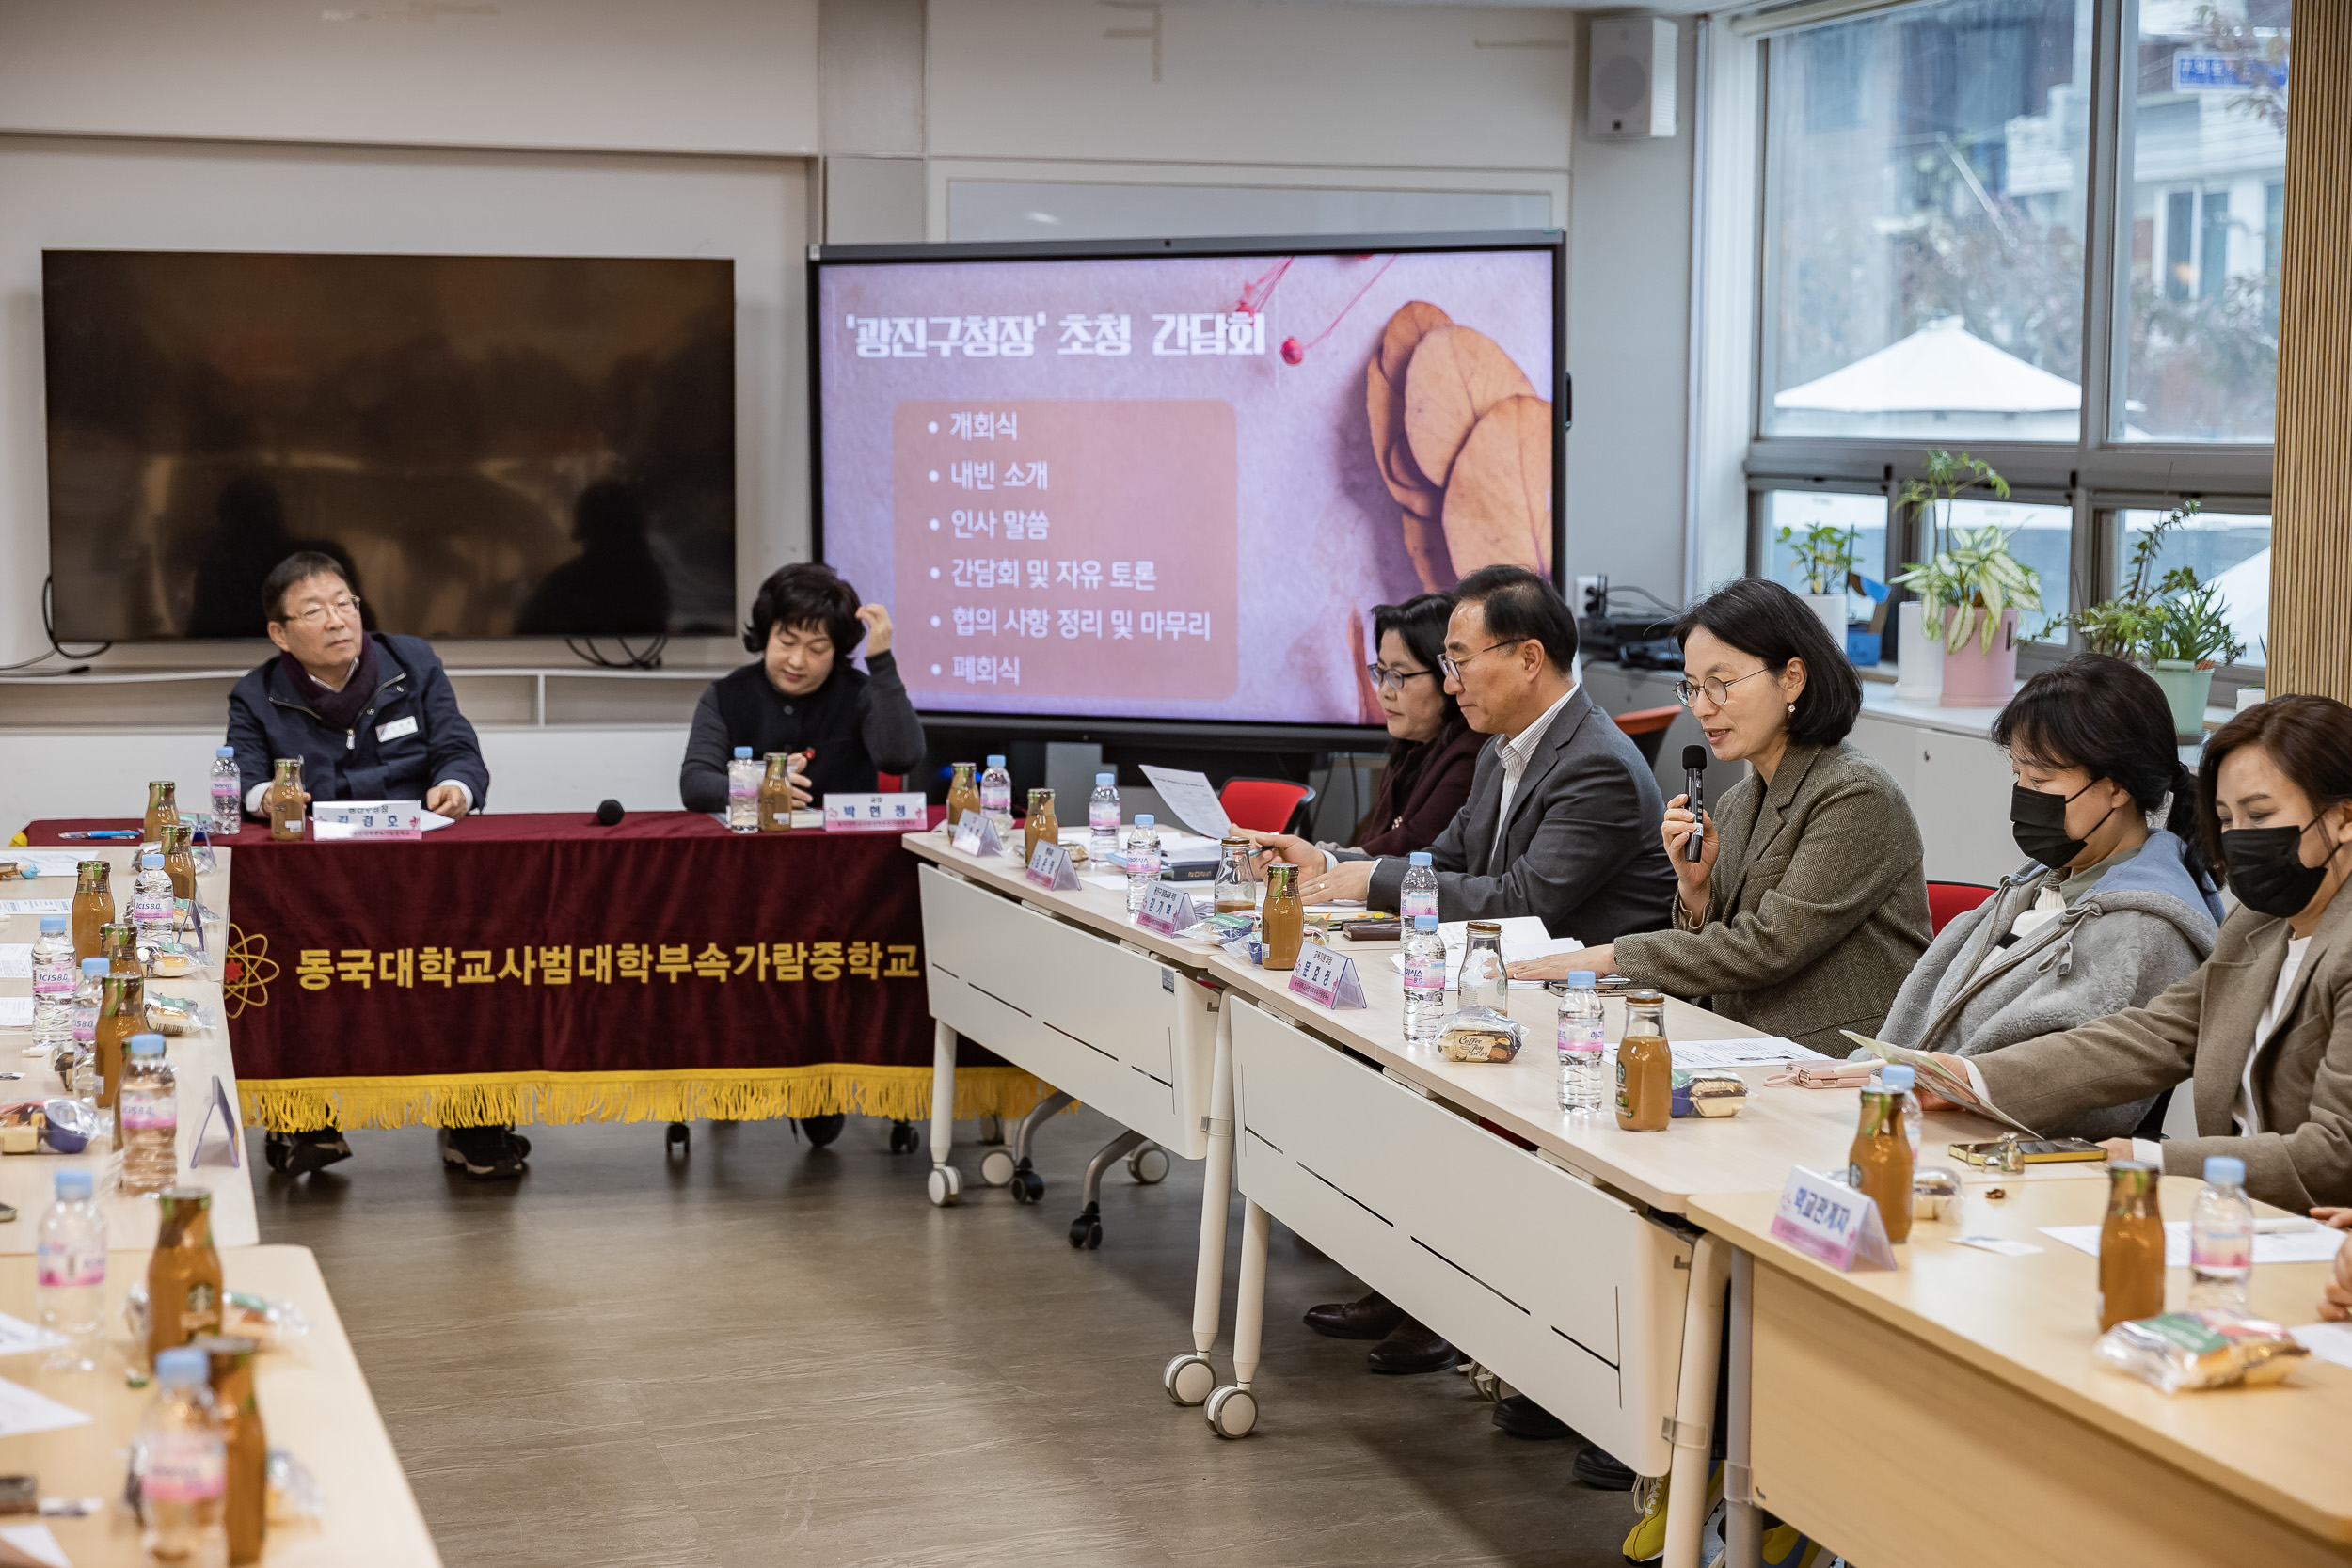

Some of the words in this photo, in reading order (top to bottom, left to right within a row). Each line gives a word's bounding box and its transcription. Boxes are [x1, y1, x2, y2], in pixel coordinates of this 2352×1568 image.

[1057, 314, 1132, 356] 초청
[1152, 312, 1266, 356] 간담회
[950, 412, 1018, 441] 개회식
[950, 461, 996, 490] 내빈
[1003, 461, 1049, 491] 소개
[951, 510, 998, 540] 인사
[1003, 510, 1050, 541] 말씀
[951, 559, 1020, 590] 간담회
[1027, 560, 1049, 590] 및
[1056, 560, 1104, 591] 자유
[1110, 561, 1157, 592] 토론
[952, 607, 998, 637] 협의
[1004, 608, 1050, 640] 사항
[1057, 610, 1103, 640] 정리
[1111, 610, 1134, 641] 및
[1139, 611, 1212, 642] 마무리
[952, 656, 1021, 686] 폐회식
[39, 973, 56, 982] ICIS
[296, 942, 920, 990] 동국대학교사범대학부속가람중학교
[1458, 1035, 1483, 1046] Coffee
[1468, 1043, 1485, 1053] Joy
